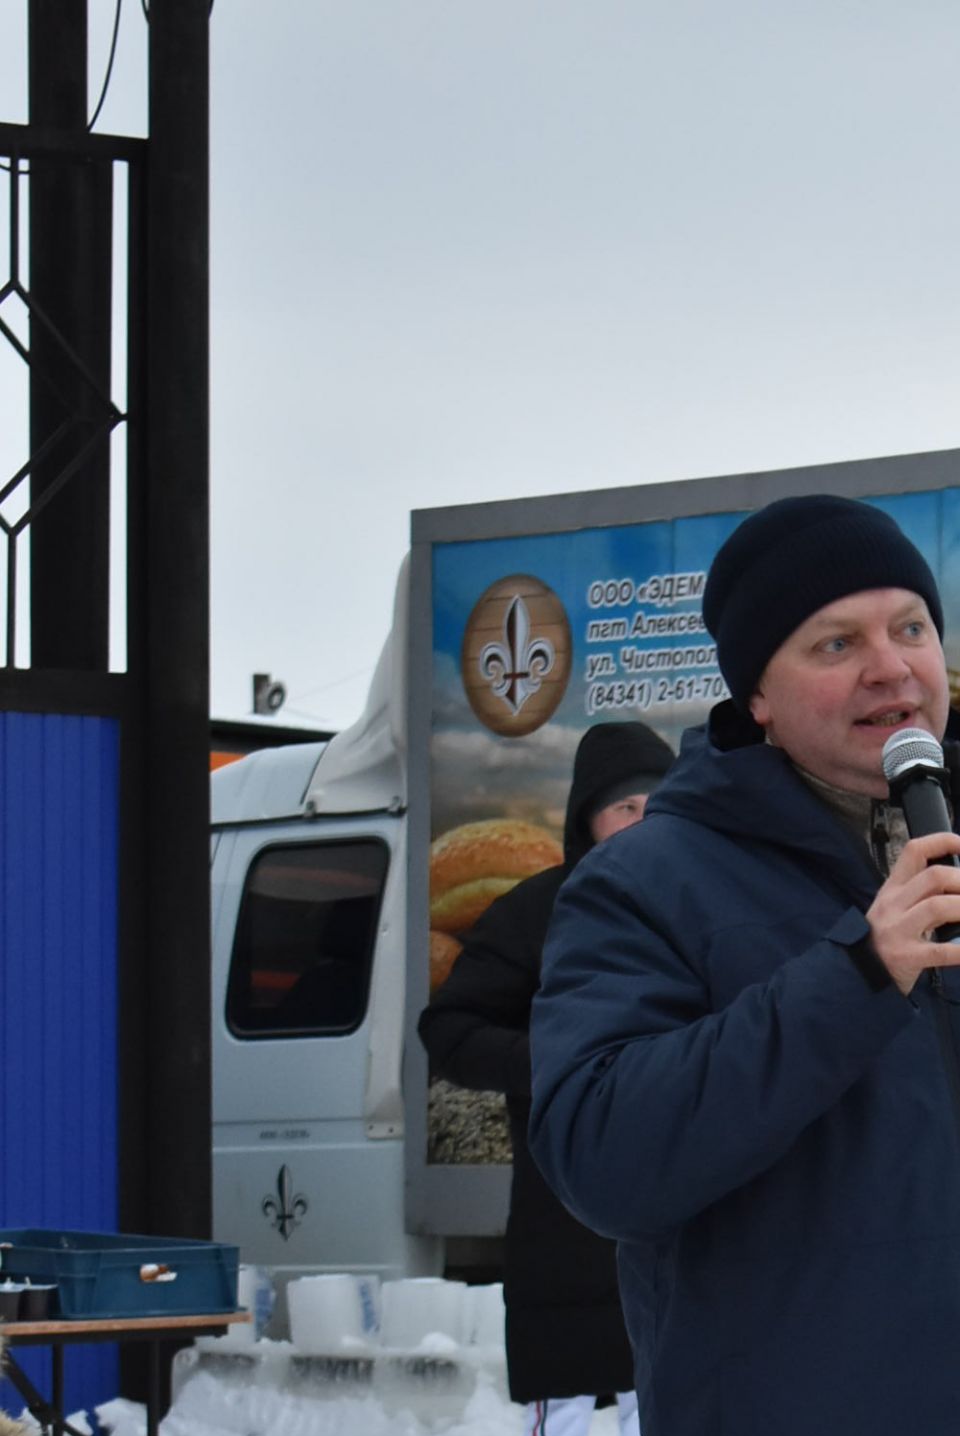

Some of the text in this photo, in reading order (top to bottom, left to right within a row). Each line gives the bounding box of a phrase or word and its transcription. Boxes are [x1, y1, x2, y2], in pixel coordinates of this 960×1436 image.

[589, 574, 704, 606] ООО «ЭДЕМ
[588, 619, 626, 641] пгт
[588, 654, 615, 678] ул.
[588, 681, 652, 713] (84341)
